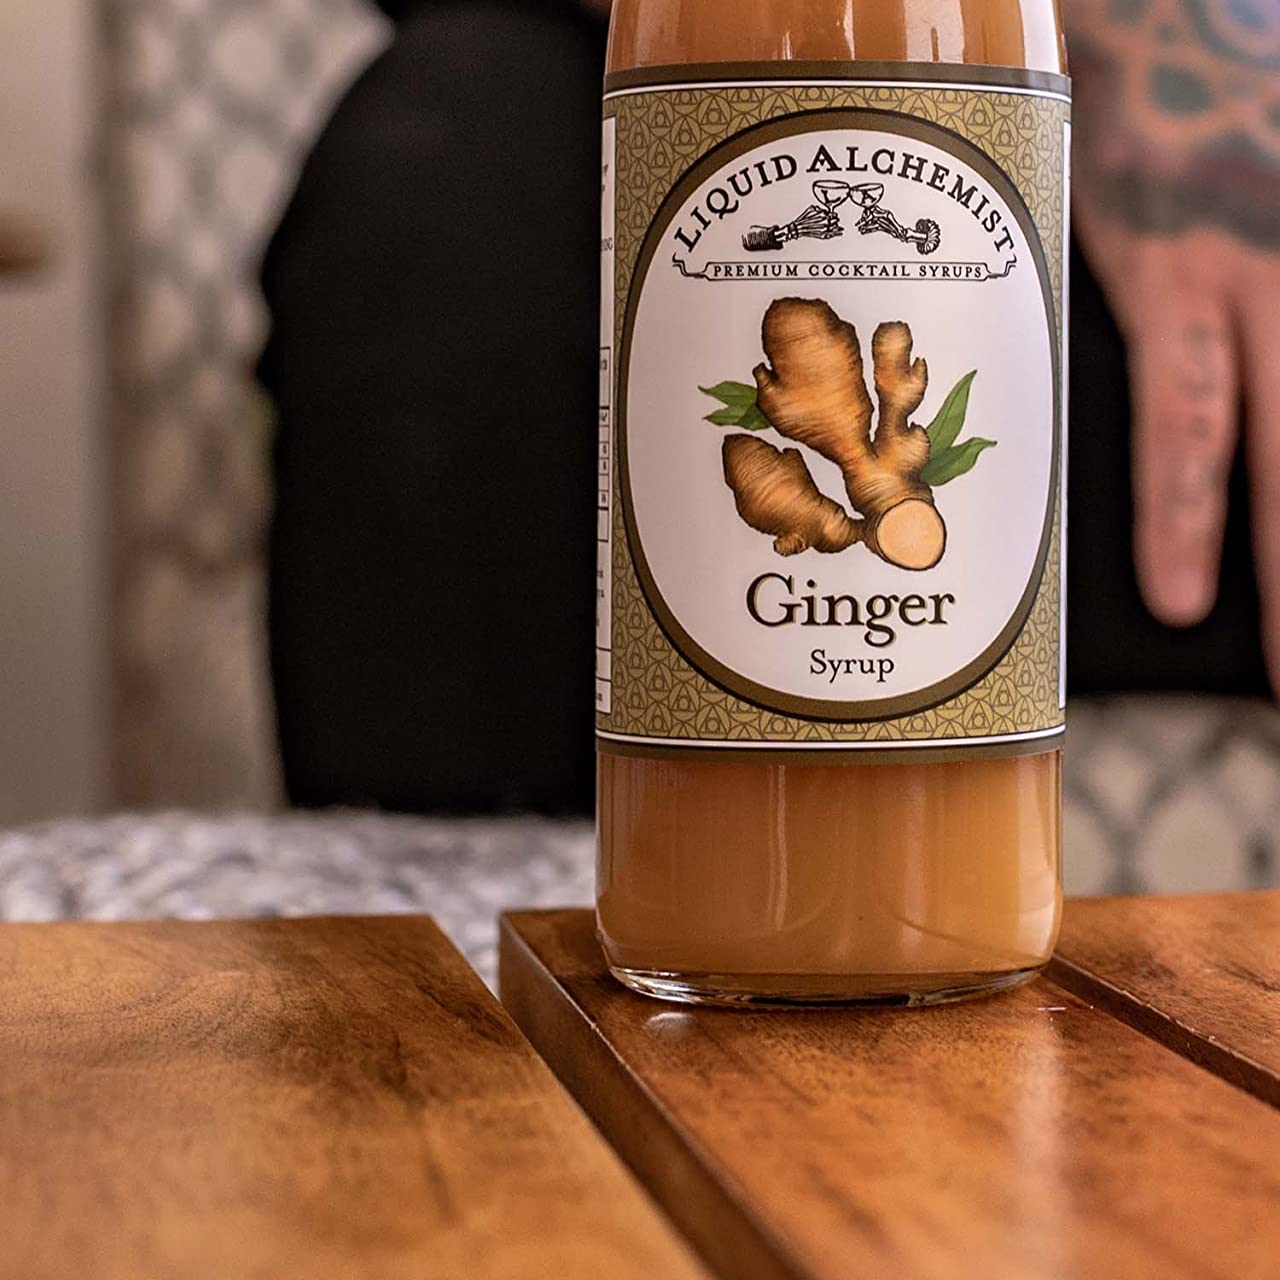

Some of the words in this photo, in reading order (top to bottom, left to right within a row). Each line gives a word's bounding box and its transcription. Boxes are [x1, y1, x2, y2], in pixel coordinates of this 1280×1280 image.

[674, 154, 798, 253] LIQUID
[805, 144, 1015, 253] ALCHEMIST
[713, 264, 799, 278] PREMIUM
[808, 264, 910, 277] COCKTAIL
[918, 264, 982, 278] SYRUPS
[746, 572, 956, 648] Ginger
[809, 649, 895, 684] Syrup
